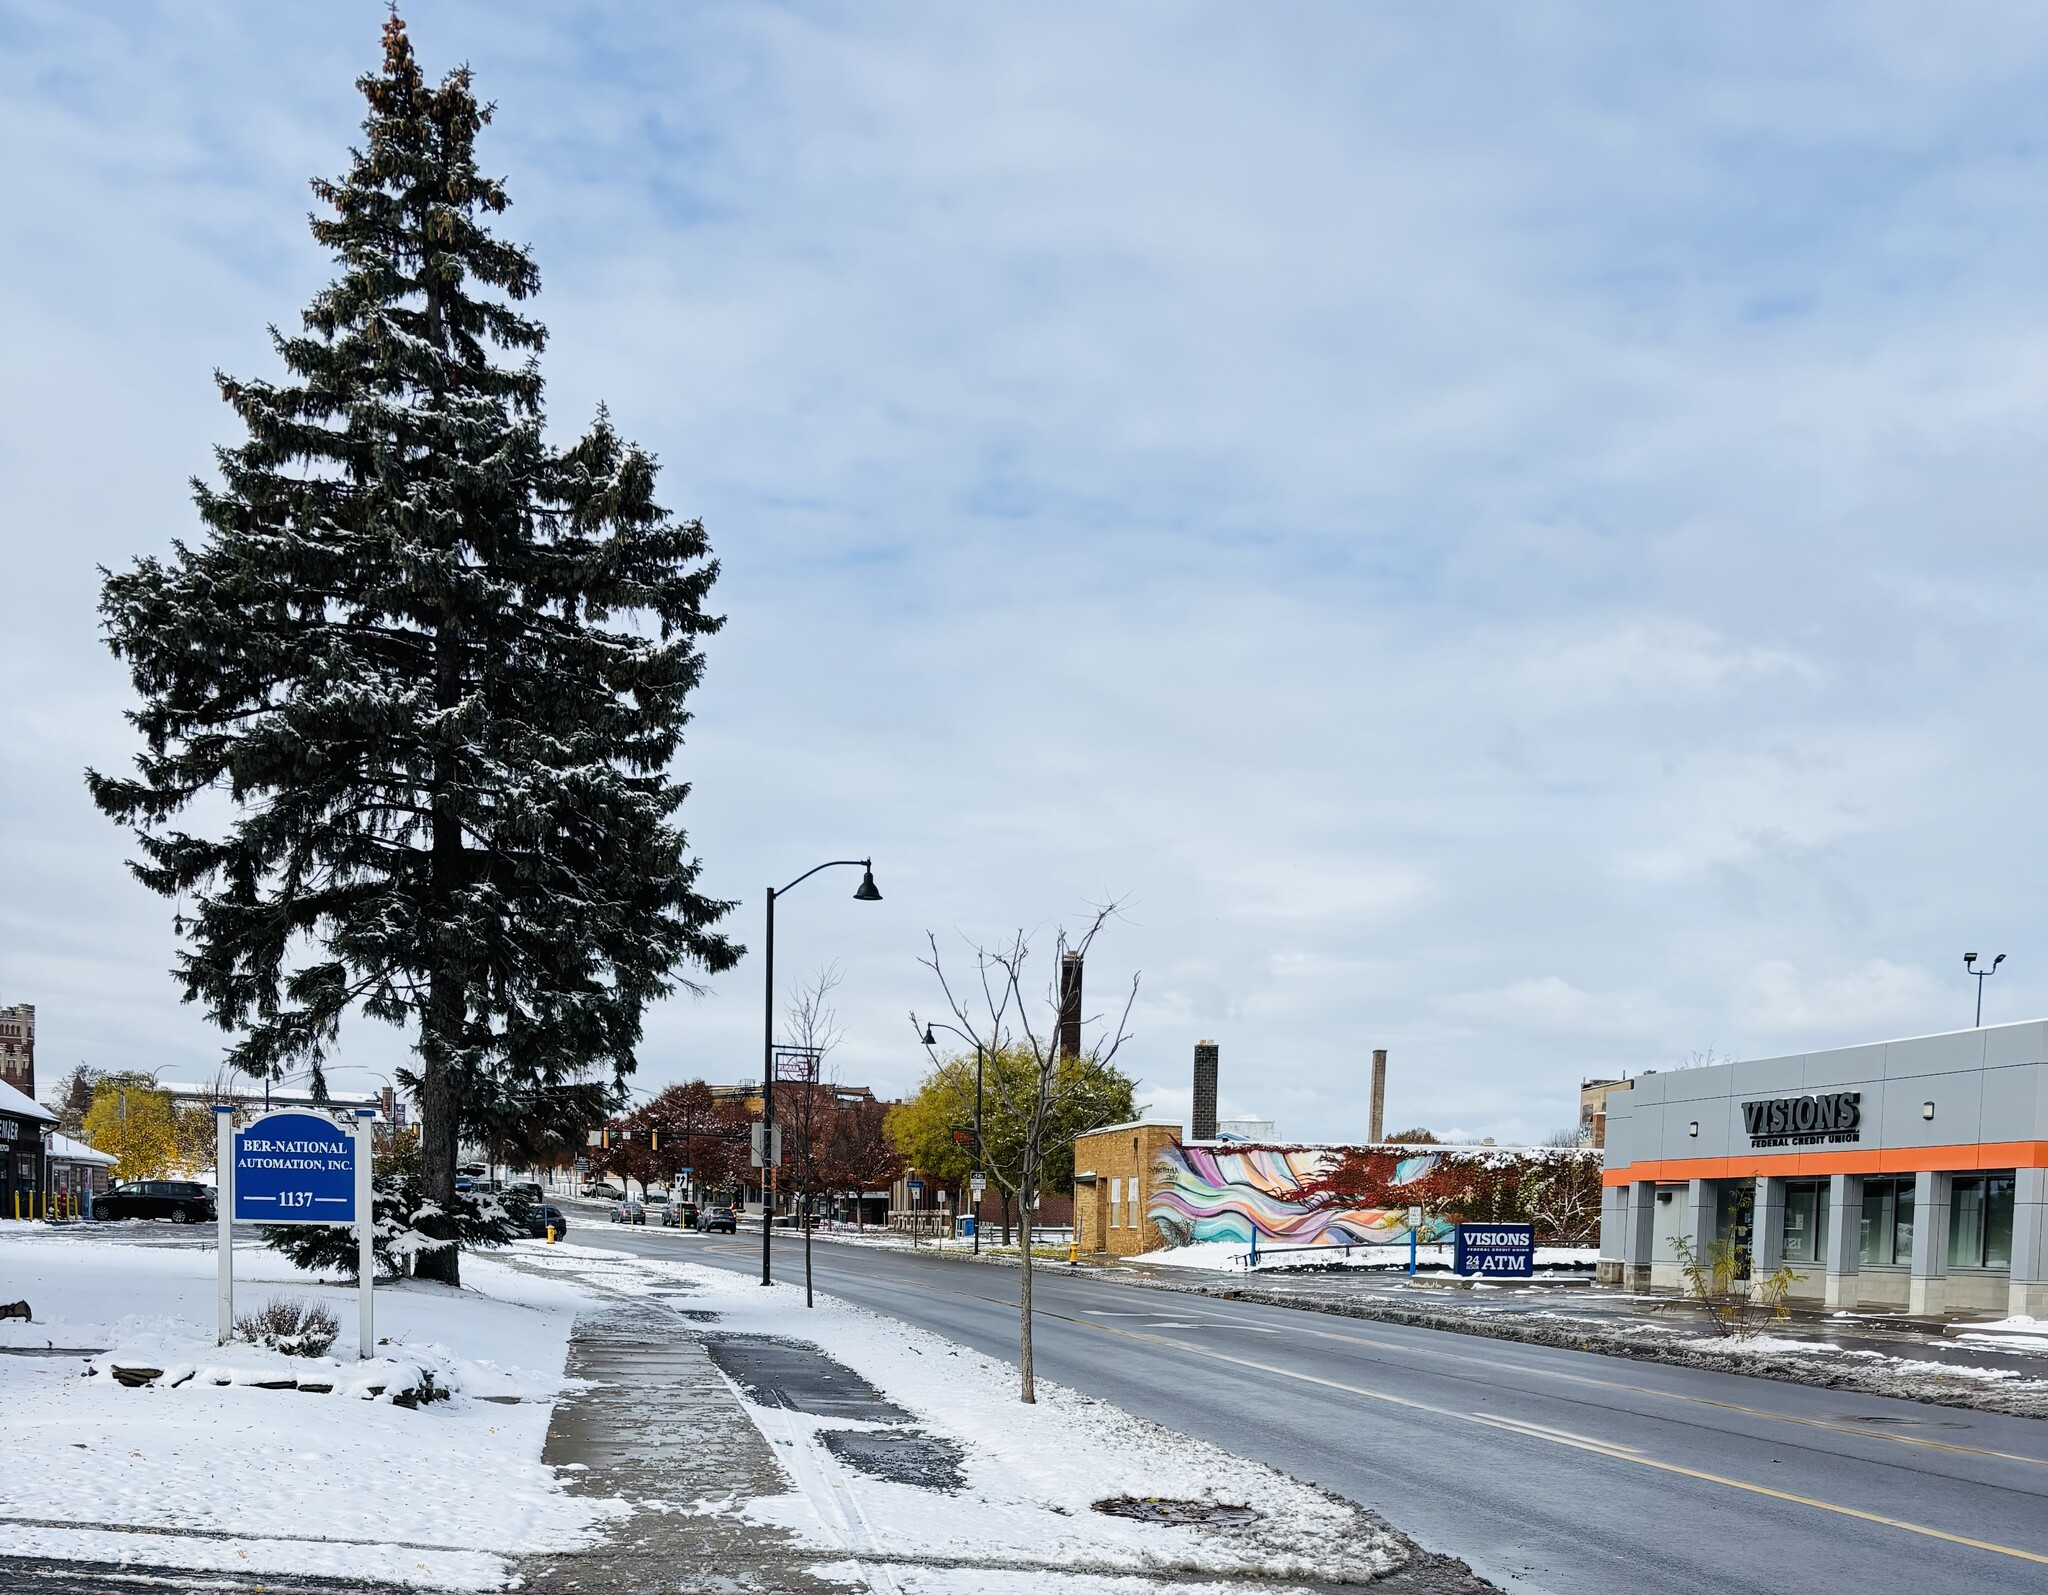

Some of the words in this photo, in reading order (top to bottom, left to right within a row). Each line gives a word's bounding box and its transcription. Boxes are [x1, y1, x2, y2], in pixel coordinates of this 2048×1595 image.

[1741, 1092, 1860, 1134] VISIONS
[243, 1139, 348, 1154] BER-NATIONAL
[1751, 1138, 1789, 1148] FEDERAL
[1792, 1136, 1825, 1146] CREDIT
[1828, 1133, 1860, 1144] UNION
[238, 1158, 326, 1172] AUTOMATION,
[328, 1160, 353, 1171] INC.
[279, 1191, 313, 1207] 1137
[1463, 1232, 1530, 1246] VISIONS
[1466, 1255, 1480, 1265] 24
[1481, 1255, 1526, 1270] ATM
